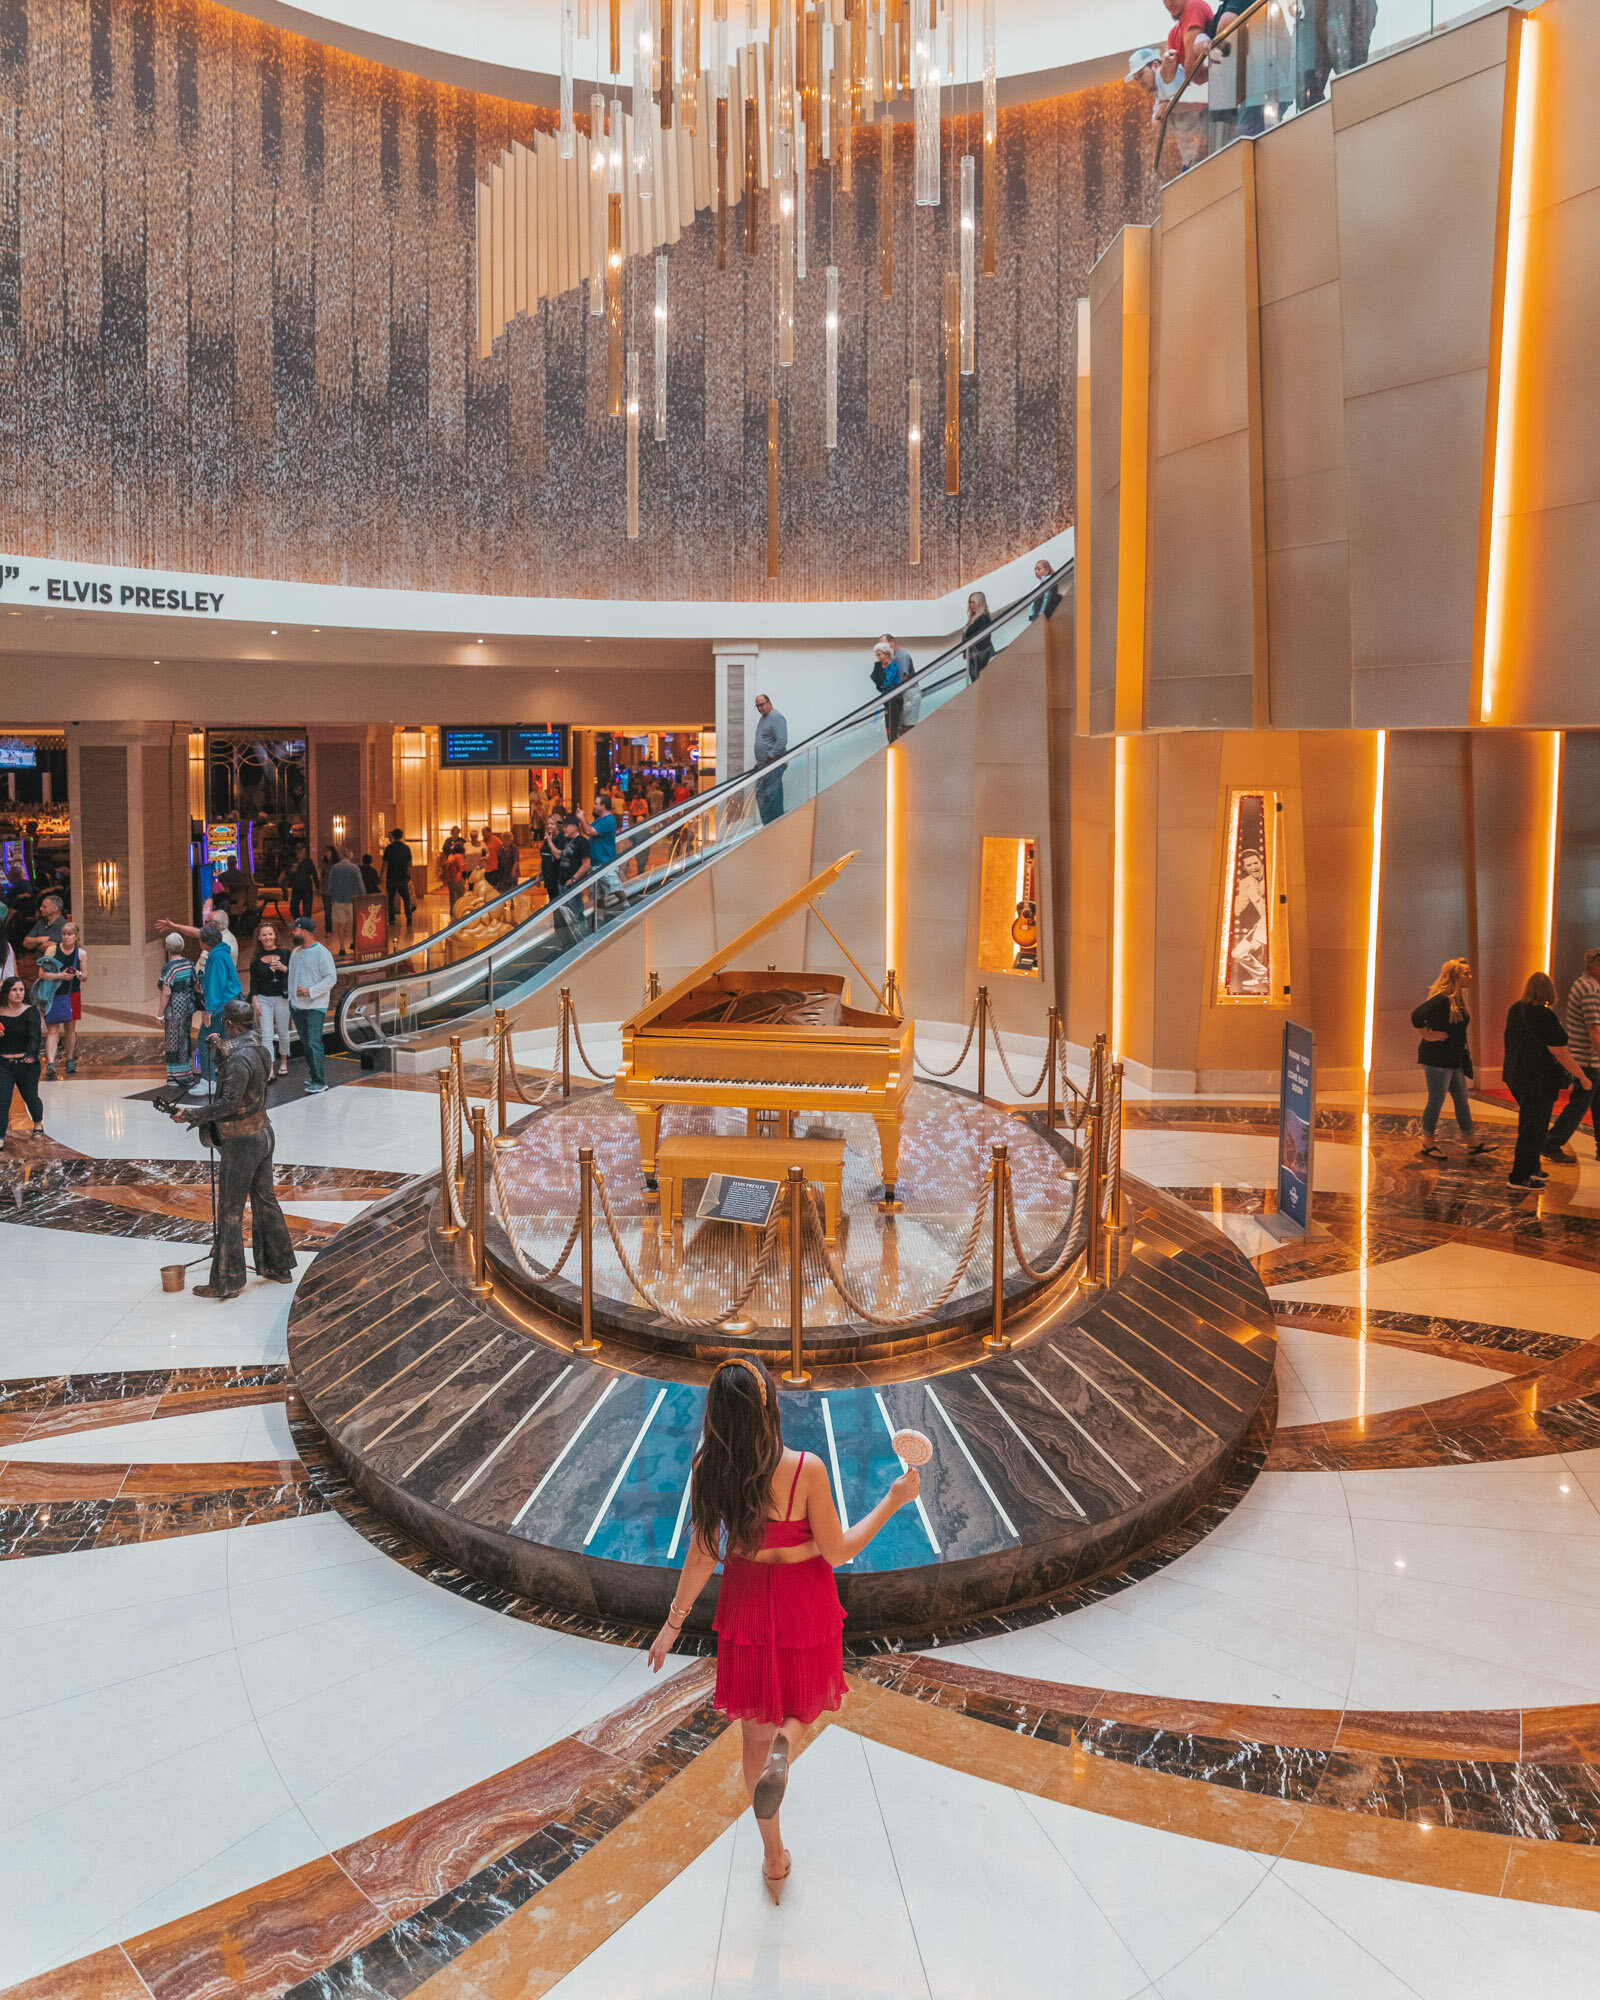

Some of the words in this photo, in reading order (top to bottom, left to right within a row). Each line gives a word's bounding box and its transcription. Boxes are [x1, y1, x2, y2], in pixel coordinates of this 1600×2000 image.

[47, 578, 112, 604] ELVIS
[120, 585, 224, 612] PRESLEY
[1301, 1056, 1310, 1066] YOU
[1291, 1083, 1303, 1095] SOON
